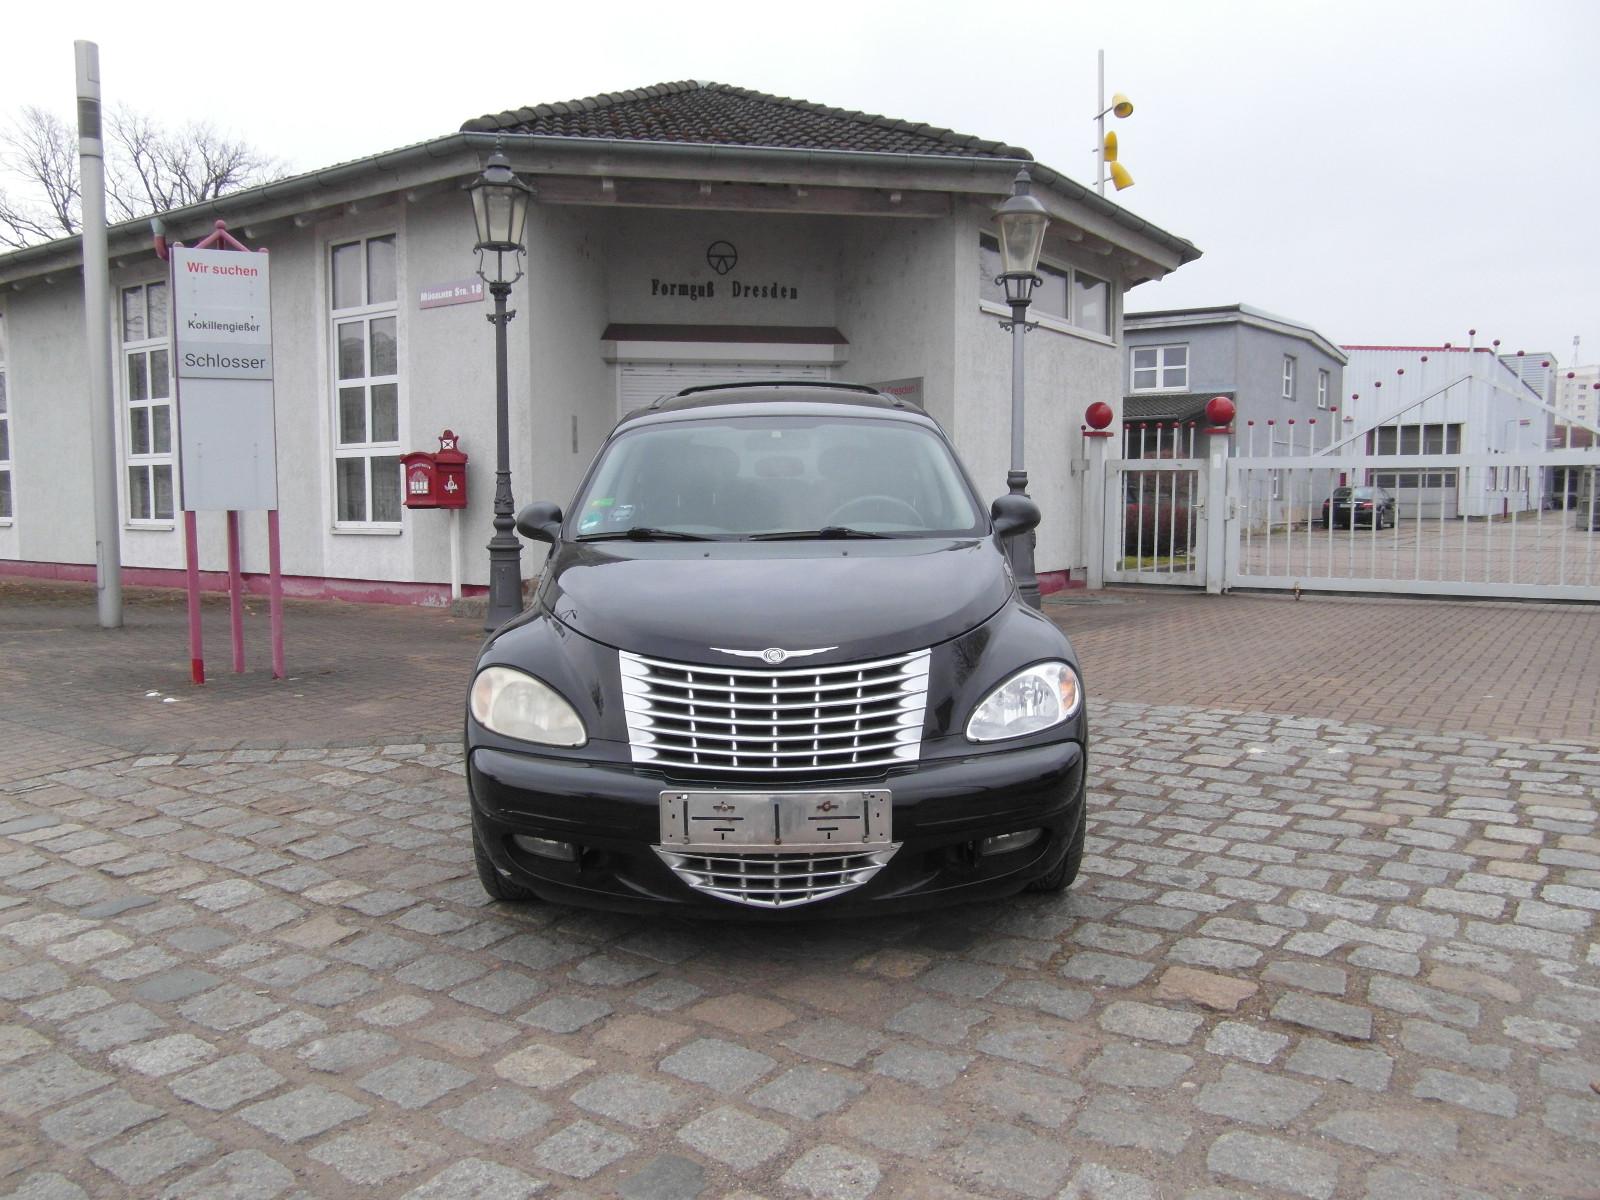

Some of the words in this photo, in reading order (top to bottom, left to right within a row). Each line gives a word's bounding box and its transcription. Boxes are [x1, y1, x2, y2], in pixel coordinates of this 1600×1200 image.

[187, 262, 209, 274] Wir
[212, 264, 258, 277] suchen
[651, 279, 714, 301] Formguß
[732, 280, 798, 299] Dresden
[188, 319, 260, 333] Kokillengießer
[185, 353, 266, 369] Schlosser
